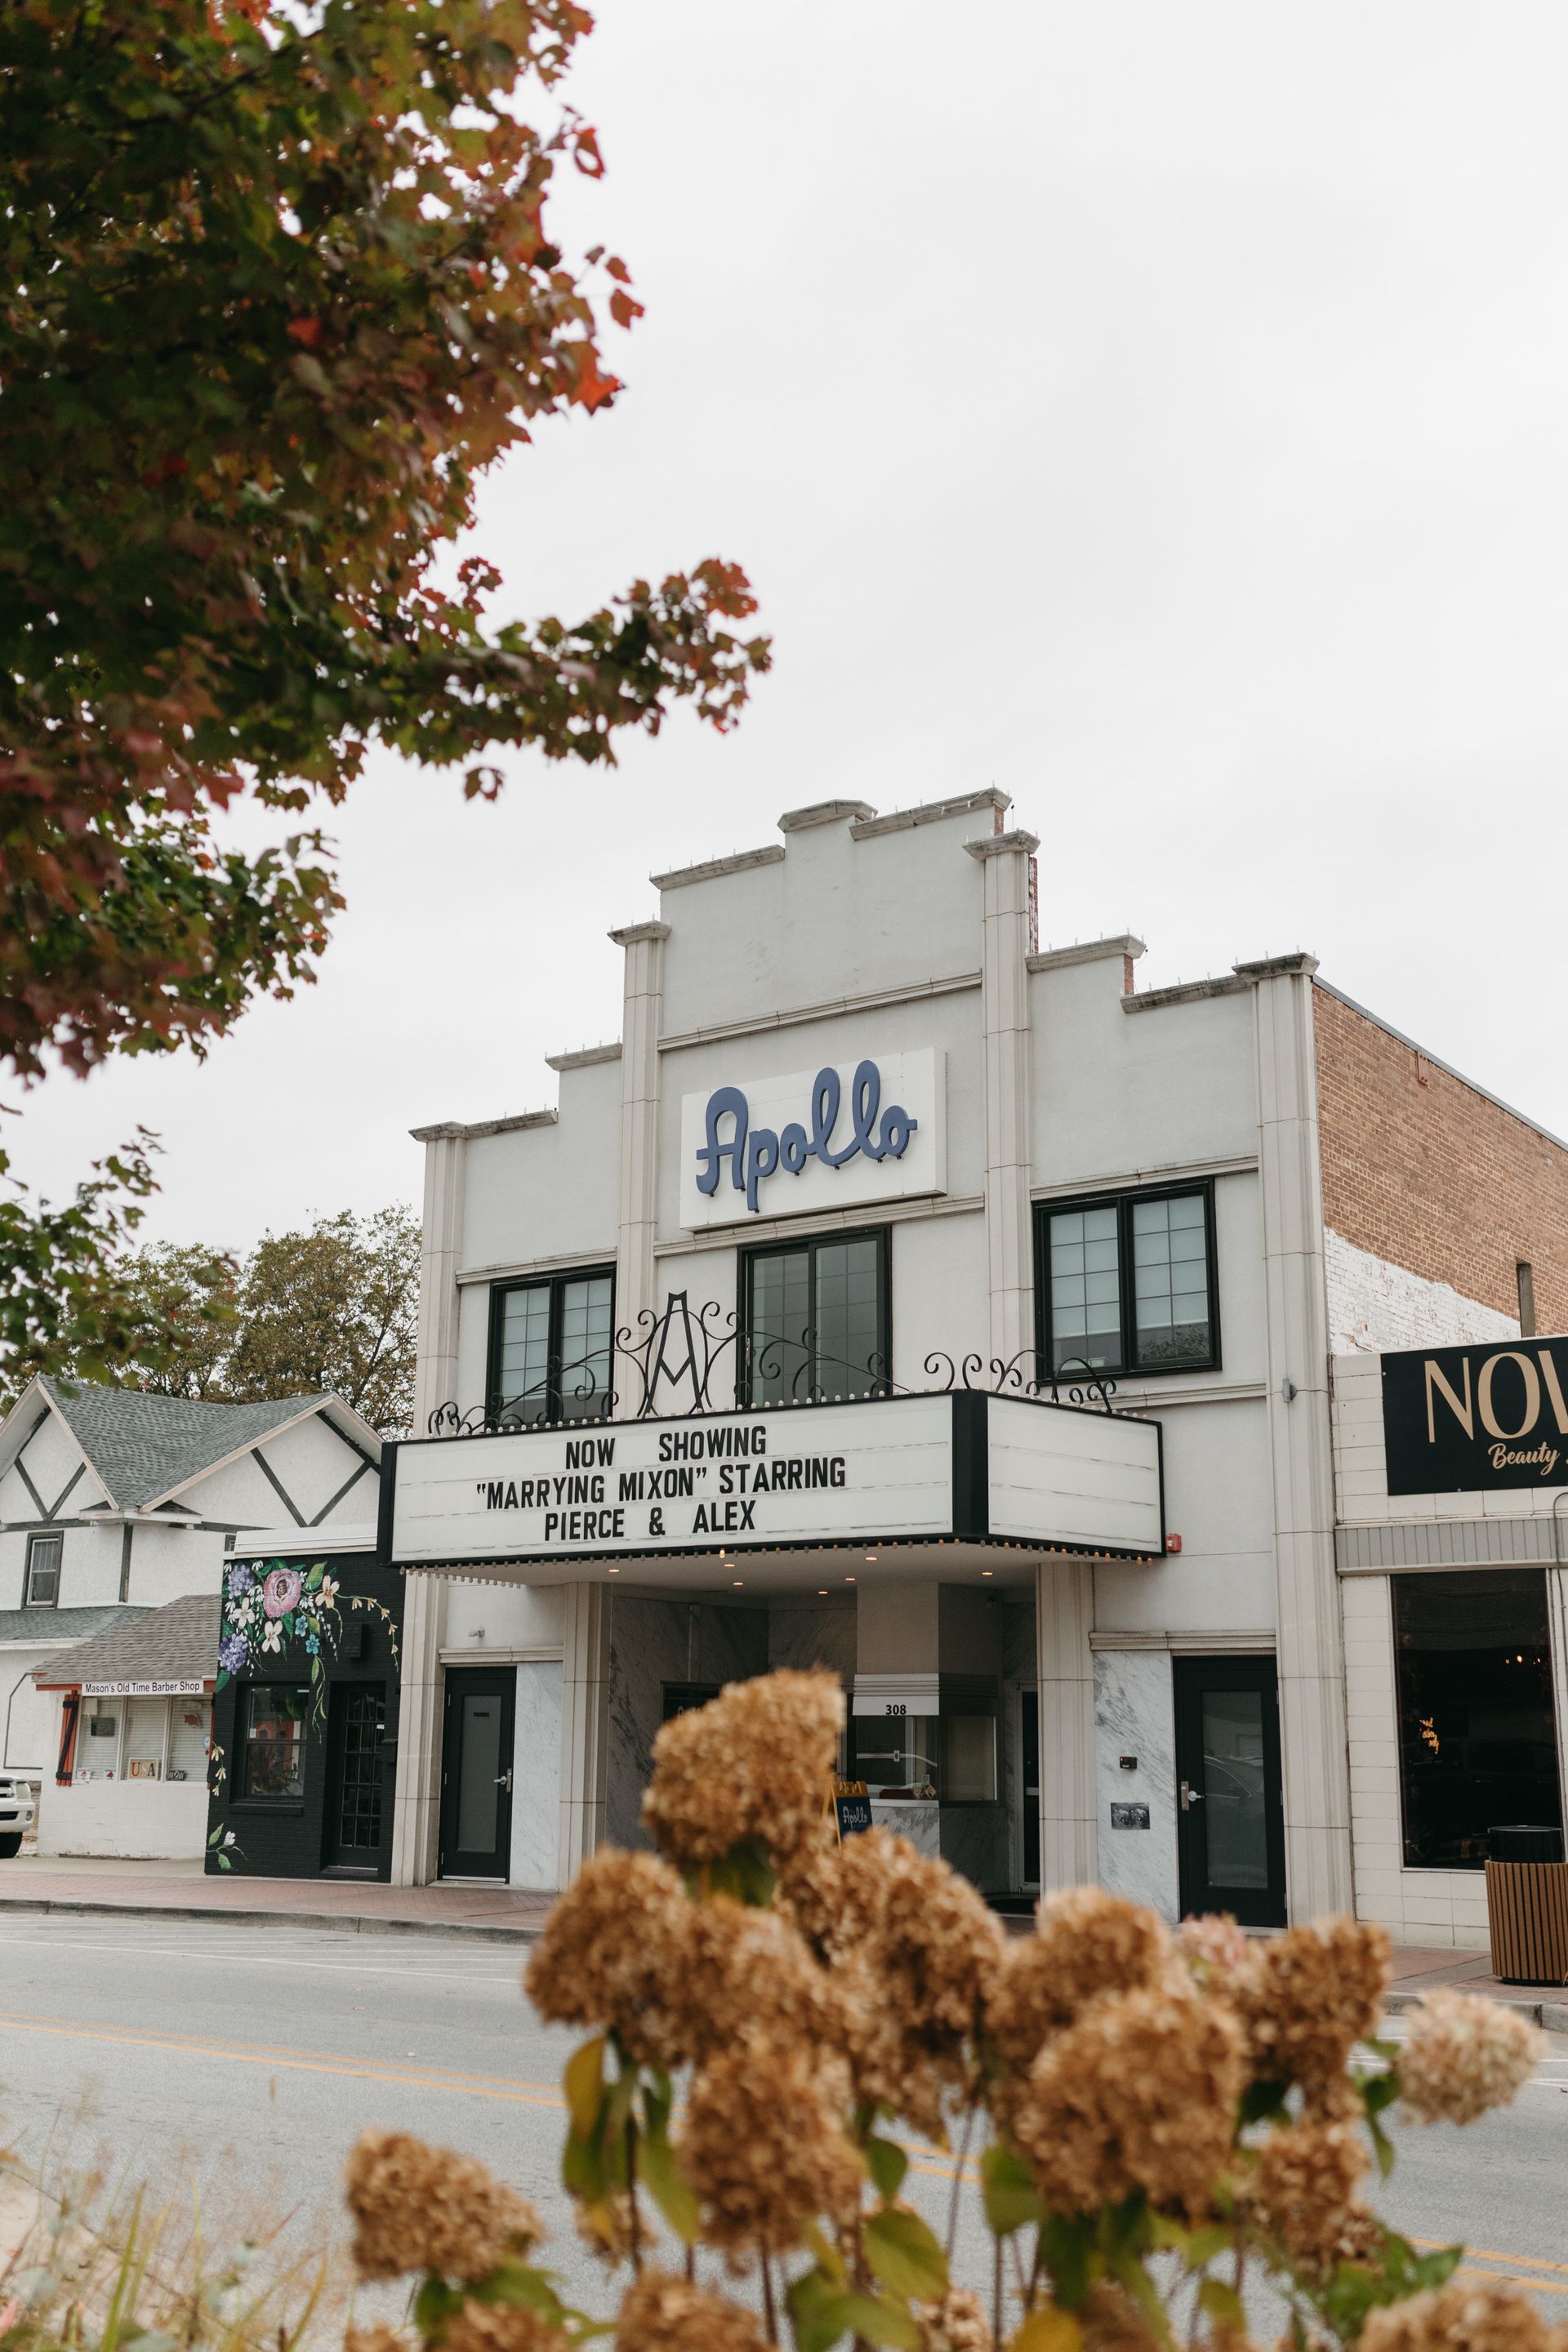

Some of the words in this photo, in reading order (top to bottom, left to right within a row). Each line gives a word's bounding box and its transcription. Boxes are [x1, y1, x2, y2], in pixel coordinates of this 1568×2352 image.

[696, 1059, 917, 1211] Apollo
[566, 1437, 615, 1469] NOW
[659, 1425, 766, 1462] SHOWING
[1488, 1441, 1561, 1476] Beauty
[477, 1475, 604, 1509] "MARRYING
[619, 1467, 707, 1502] MIXON"
[719, 1457, 845, 1494] STARRING
[545, 1508, 625, 1541] PIERCE
[648, 1507, 666, 1536] &
[693, 1499, 756, 1534] ALEX
[85, 1683, 114, 1693] Mason's
[117, 1682, 130, 1692] Old
[131, 1682, 149, 1692] Time
[152, 1682, 177, 1691] Barber
[180, 1682, 200, 1692] Shop
[885, 1704, 906, 1715] 308
[131, 1762, 155, 1776] USA
[843, 1806, 868, 1829] Apollo
